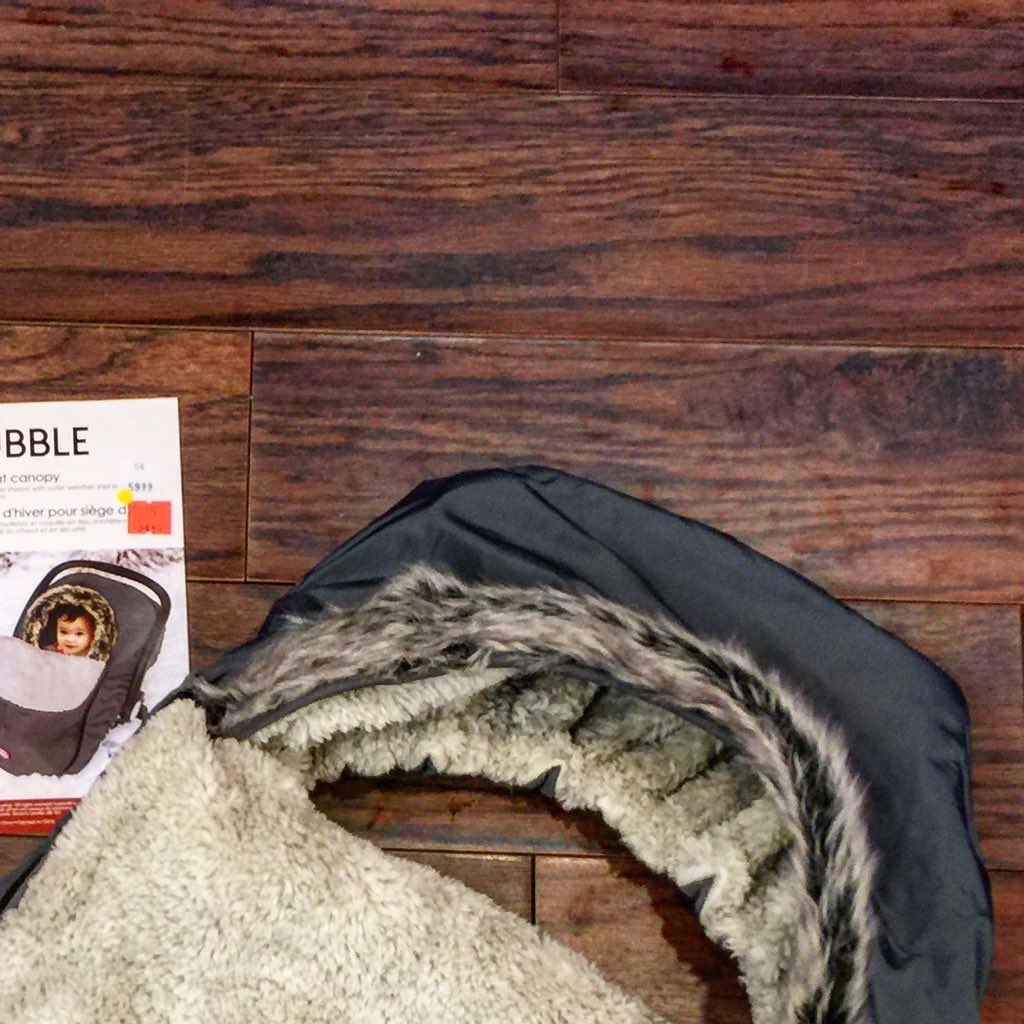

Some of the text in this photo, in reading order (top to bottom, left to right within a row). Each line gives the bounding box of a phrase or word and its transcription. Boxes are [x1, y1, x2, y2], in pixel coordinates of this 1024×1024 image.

[10, 473, 61, 484] canopy
[2, 507, 44, 519] d'hiver
[48, 508, 77, 519] pour
[80, 504, 115, 518] siège
